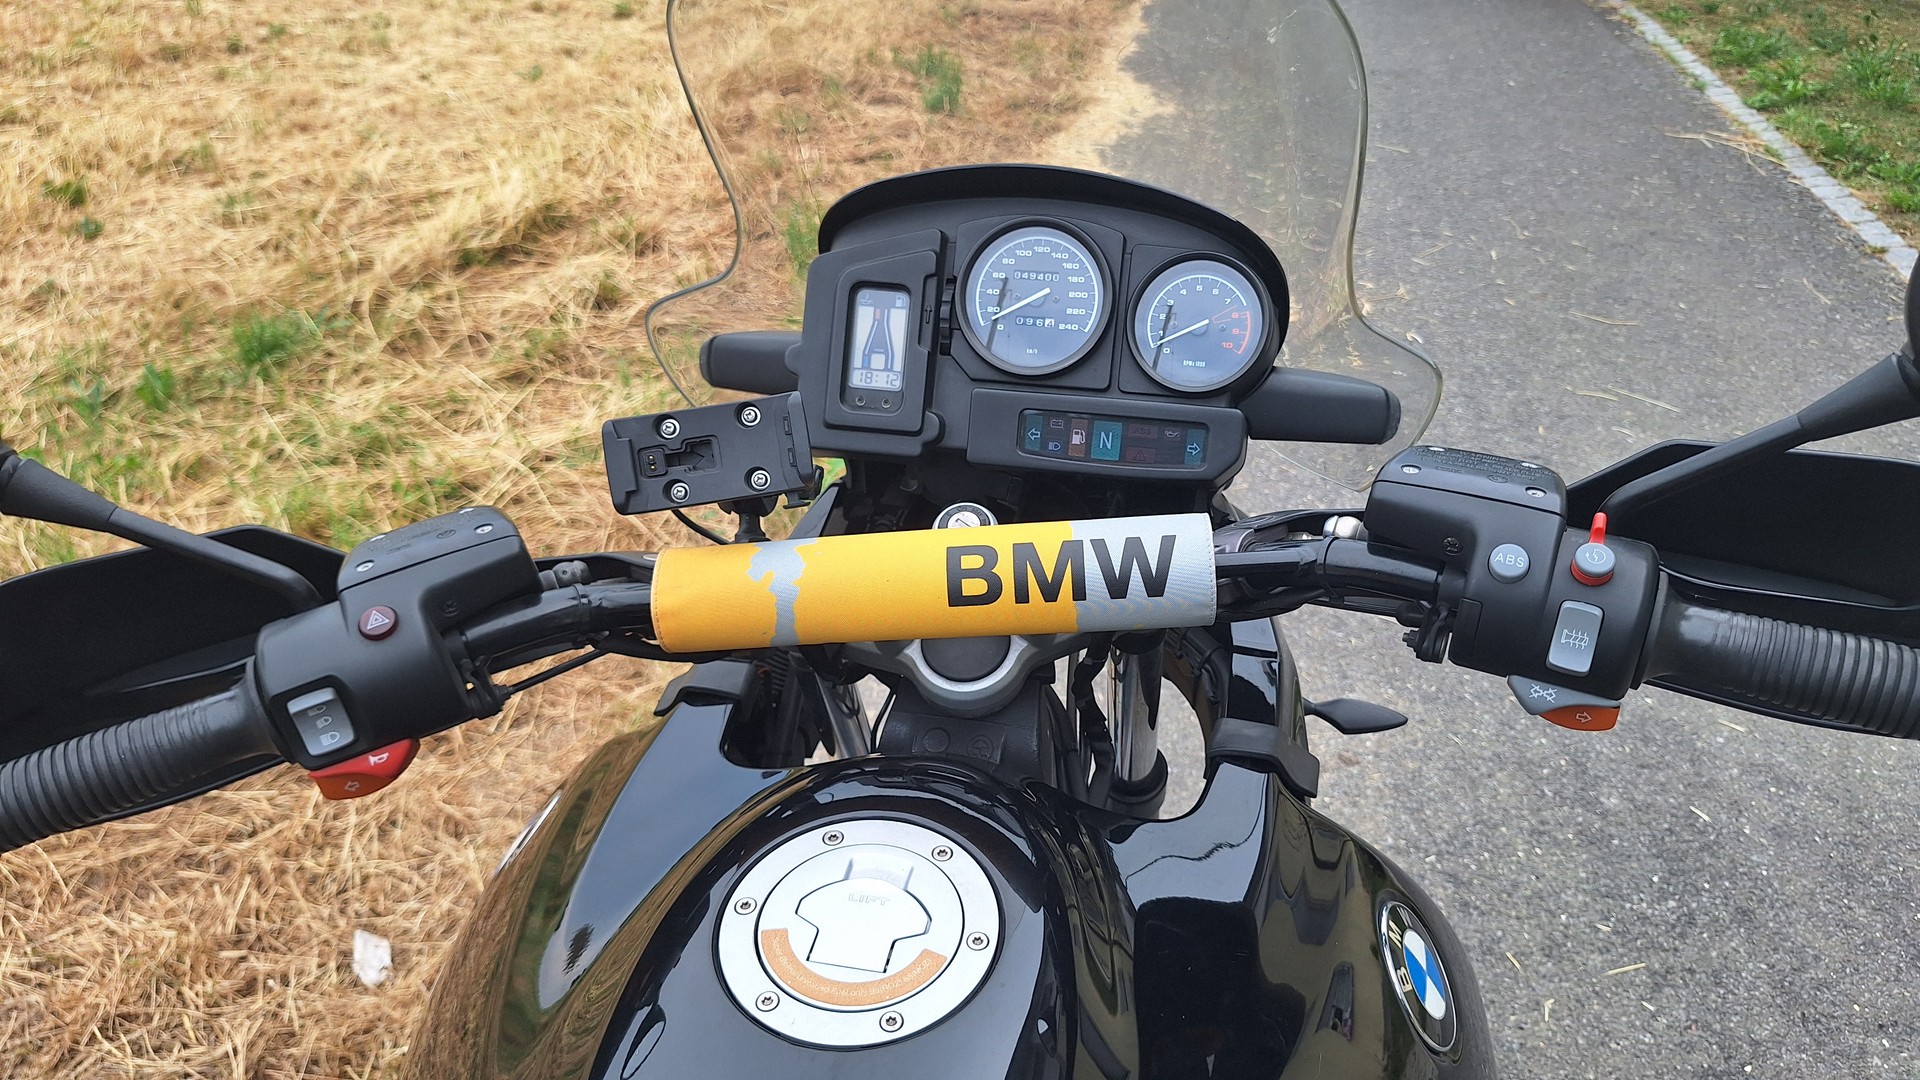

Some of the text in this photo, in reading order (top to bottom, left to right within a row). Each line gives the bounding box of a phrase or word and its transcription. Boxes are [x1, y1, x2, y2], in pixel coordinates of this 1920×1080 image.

[1014, 271, 1060, 282] 049400
[859, 371, 900, 387] 18:12
[1099, 431, 1113, 450] N
[1494, 552, 1525, 568] ABS
[946, 534, 1177, 607] BMW
[848, 893, 891, 906] LIFT
[1388, 907, 1413, 992] BMW
